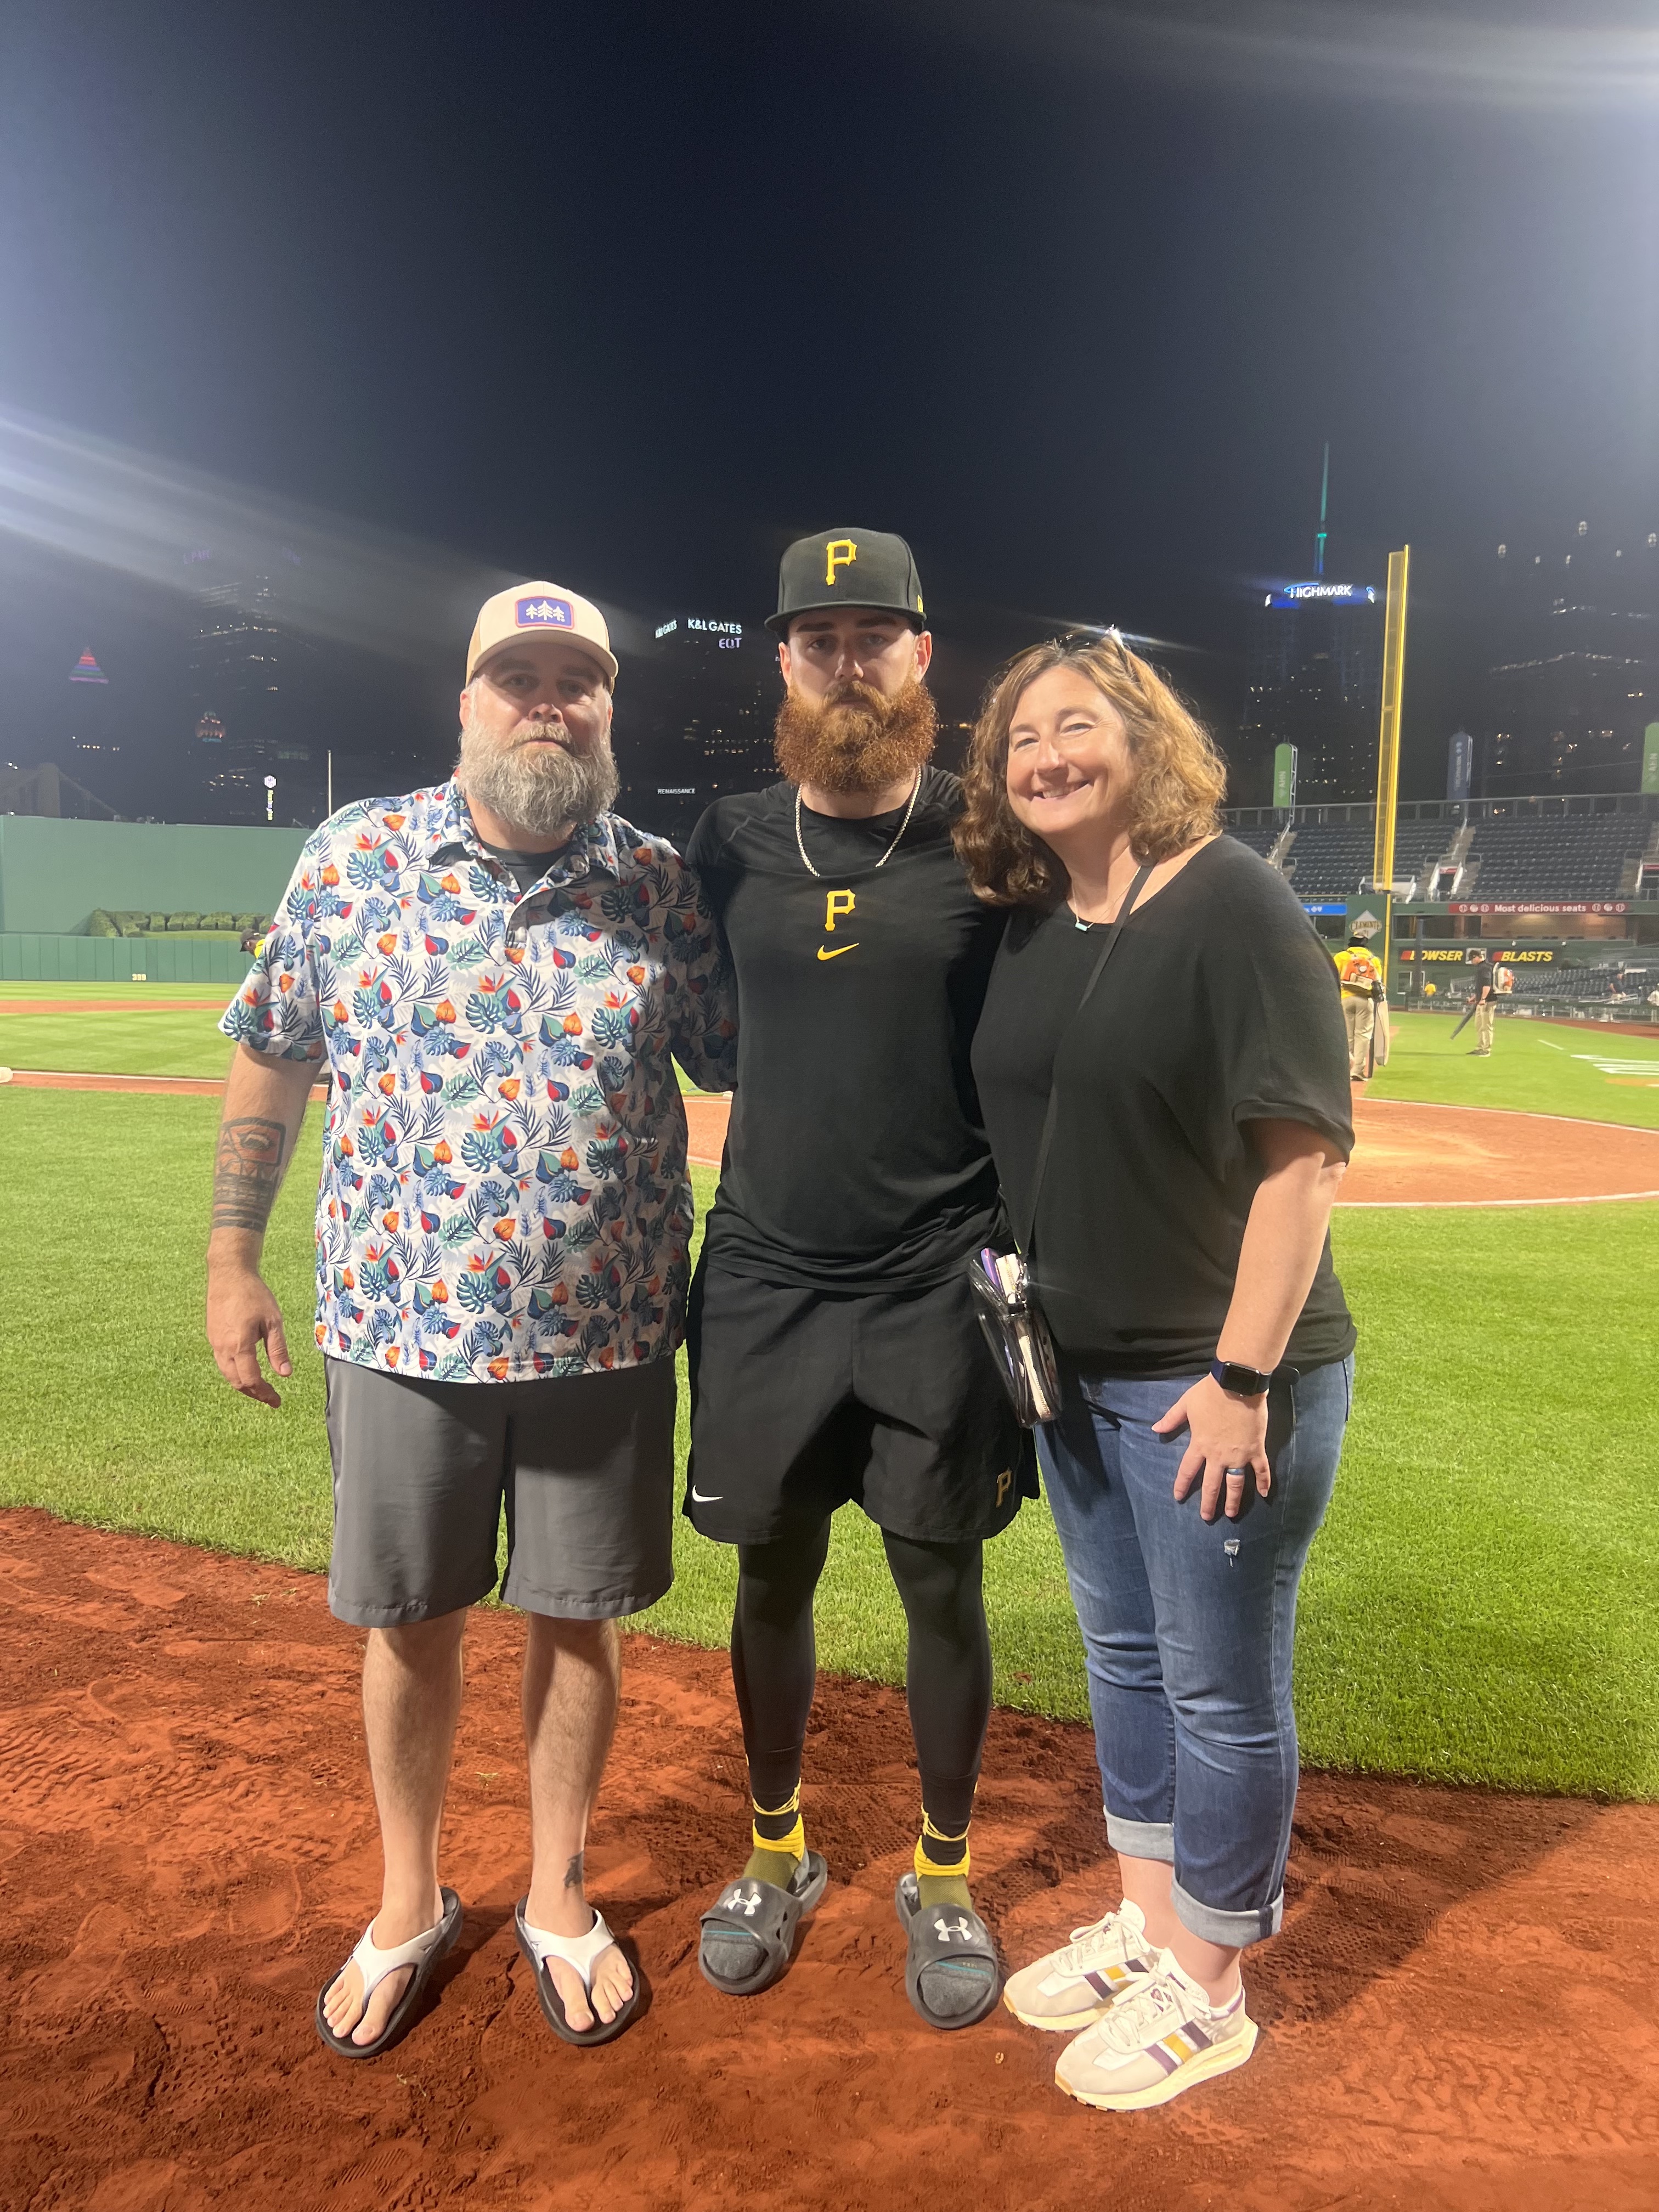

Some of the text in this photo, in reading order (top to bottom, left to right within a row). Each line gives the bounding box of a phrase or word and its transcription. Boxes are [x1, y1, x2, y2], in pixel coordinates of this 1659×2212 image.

[826, 539, 857, 586] P
[1290, 585, 1353, 599] HIGHMARK
[687, 618, 742, 634] K&L GATES
[825, 889, 856, 932] P
[1494, 904, 1587, 912] Most delicious seats
[1501, 951, 1553, 962] BLASTS
[995, 1468, 1012, 1508] P
